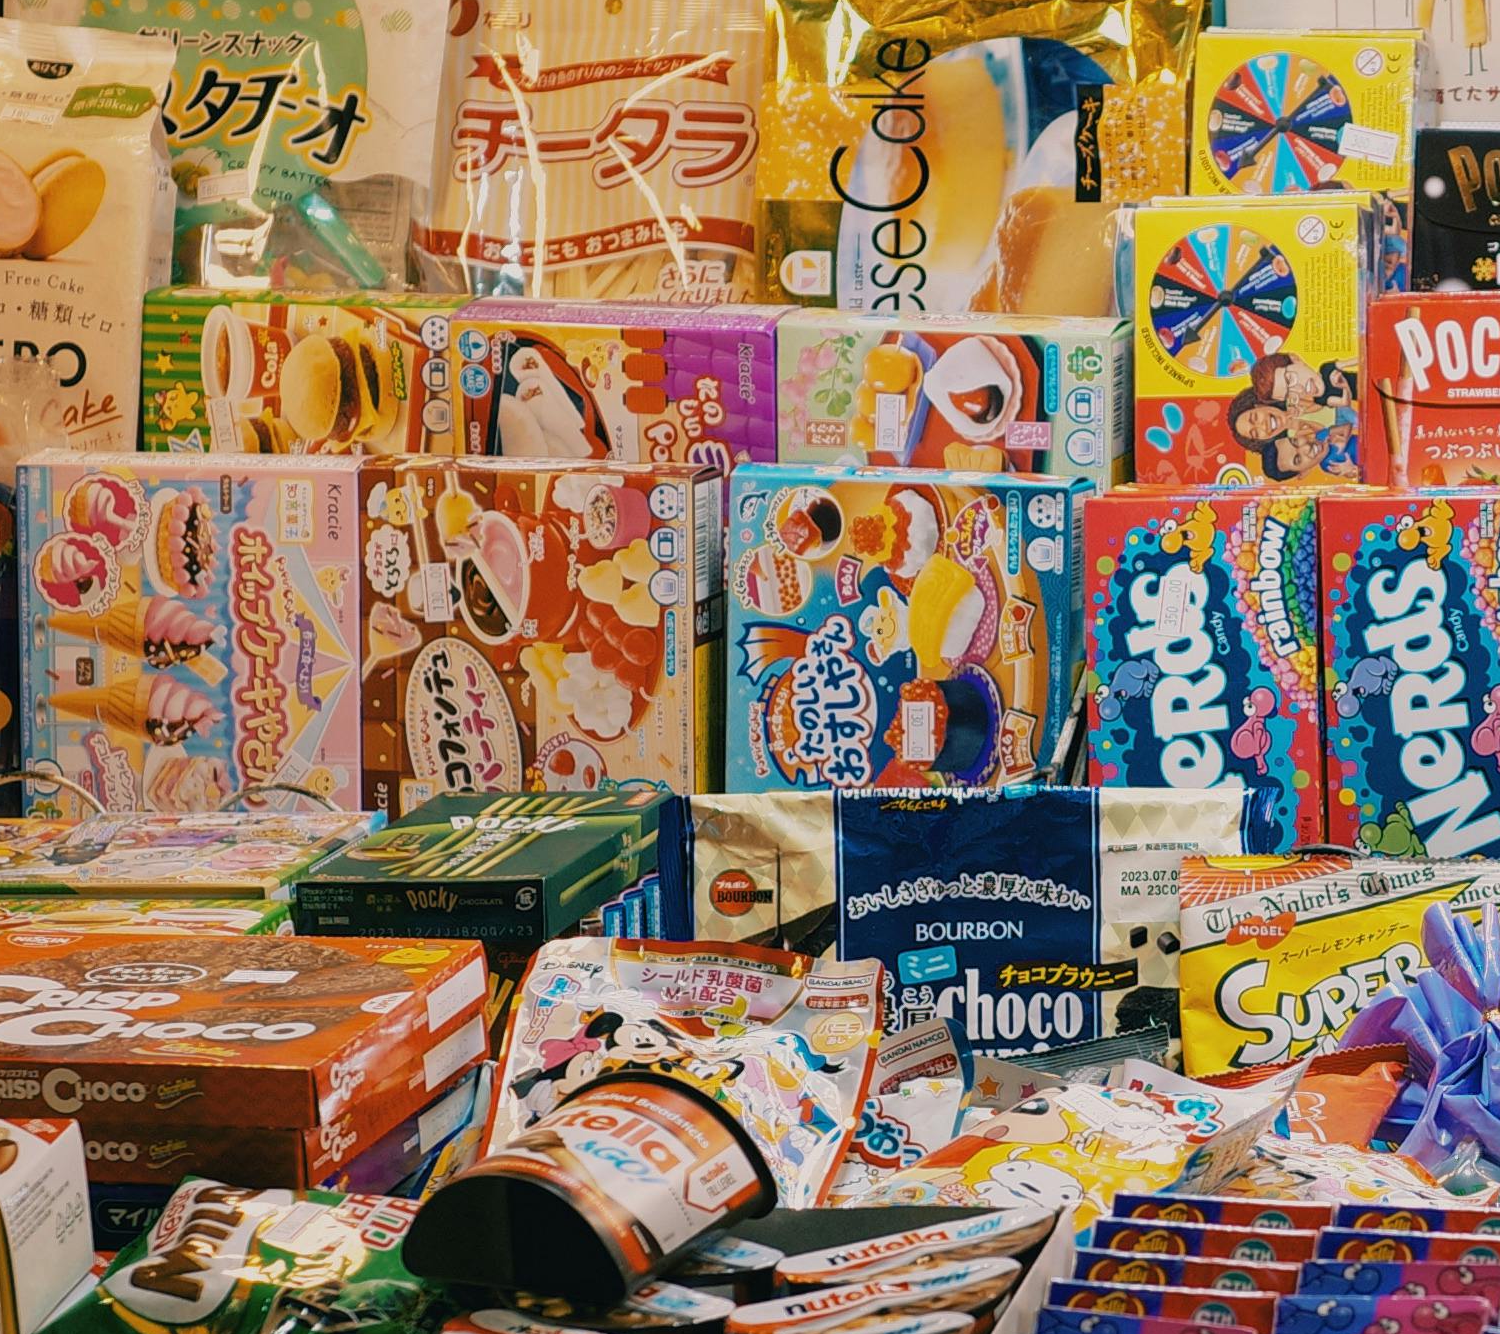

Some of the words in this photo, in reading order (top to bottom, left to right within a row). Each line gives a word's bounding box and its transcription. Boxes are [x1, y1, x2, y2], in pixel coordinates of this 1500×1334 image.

[456, 103, 752, 187] チータラ
[5, 271, 43, 290] Free
[47, 276, 86, 295] Cake
[1261, 519, 1301, 656] rainbow
[450, 815, 580, 834] Pocky
[406, 885, 459, 913] Pocky
[715, 888, 774, 905] BOURBON
[1202, 907, 1253, 935] The
[1261, 880, 1351, 920] Nobel's
[1358, 865, 1437, 899] Times
[914, 919, 1025, 944] BOURBON
[1238, 924, 1285, 937] NOBEL
[903, 953, 955, 979] ミニ
[997, 961, 1136, 992] チョコブラウニー
[641, 969, 763, 993] シールド乳酸菌
[42, 1067, 147, 1113] CHOCO
[825, 1226, 949, 1269] nutella
[783, 1279, 902, 1320] nutella
